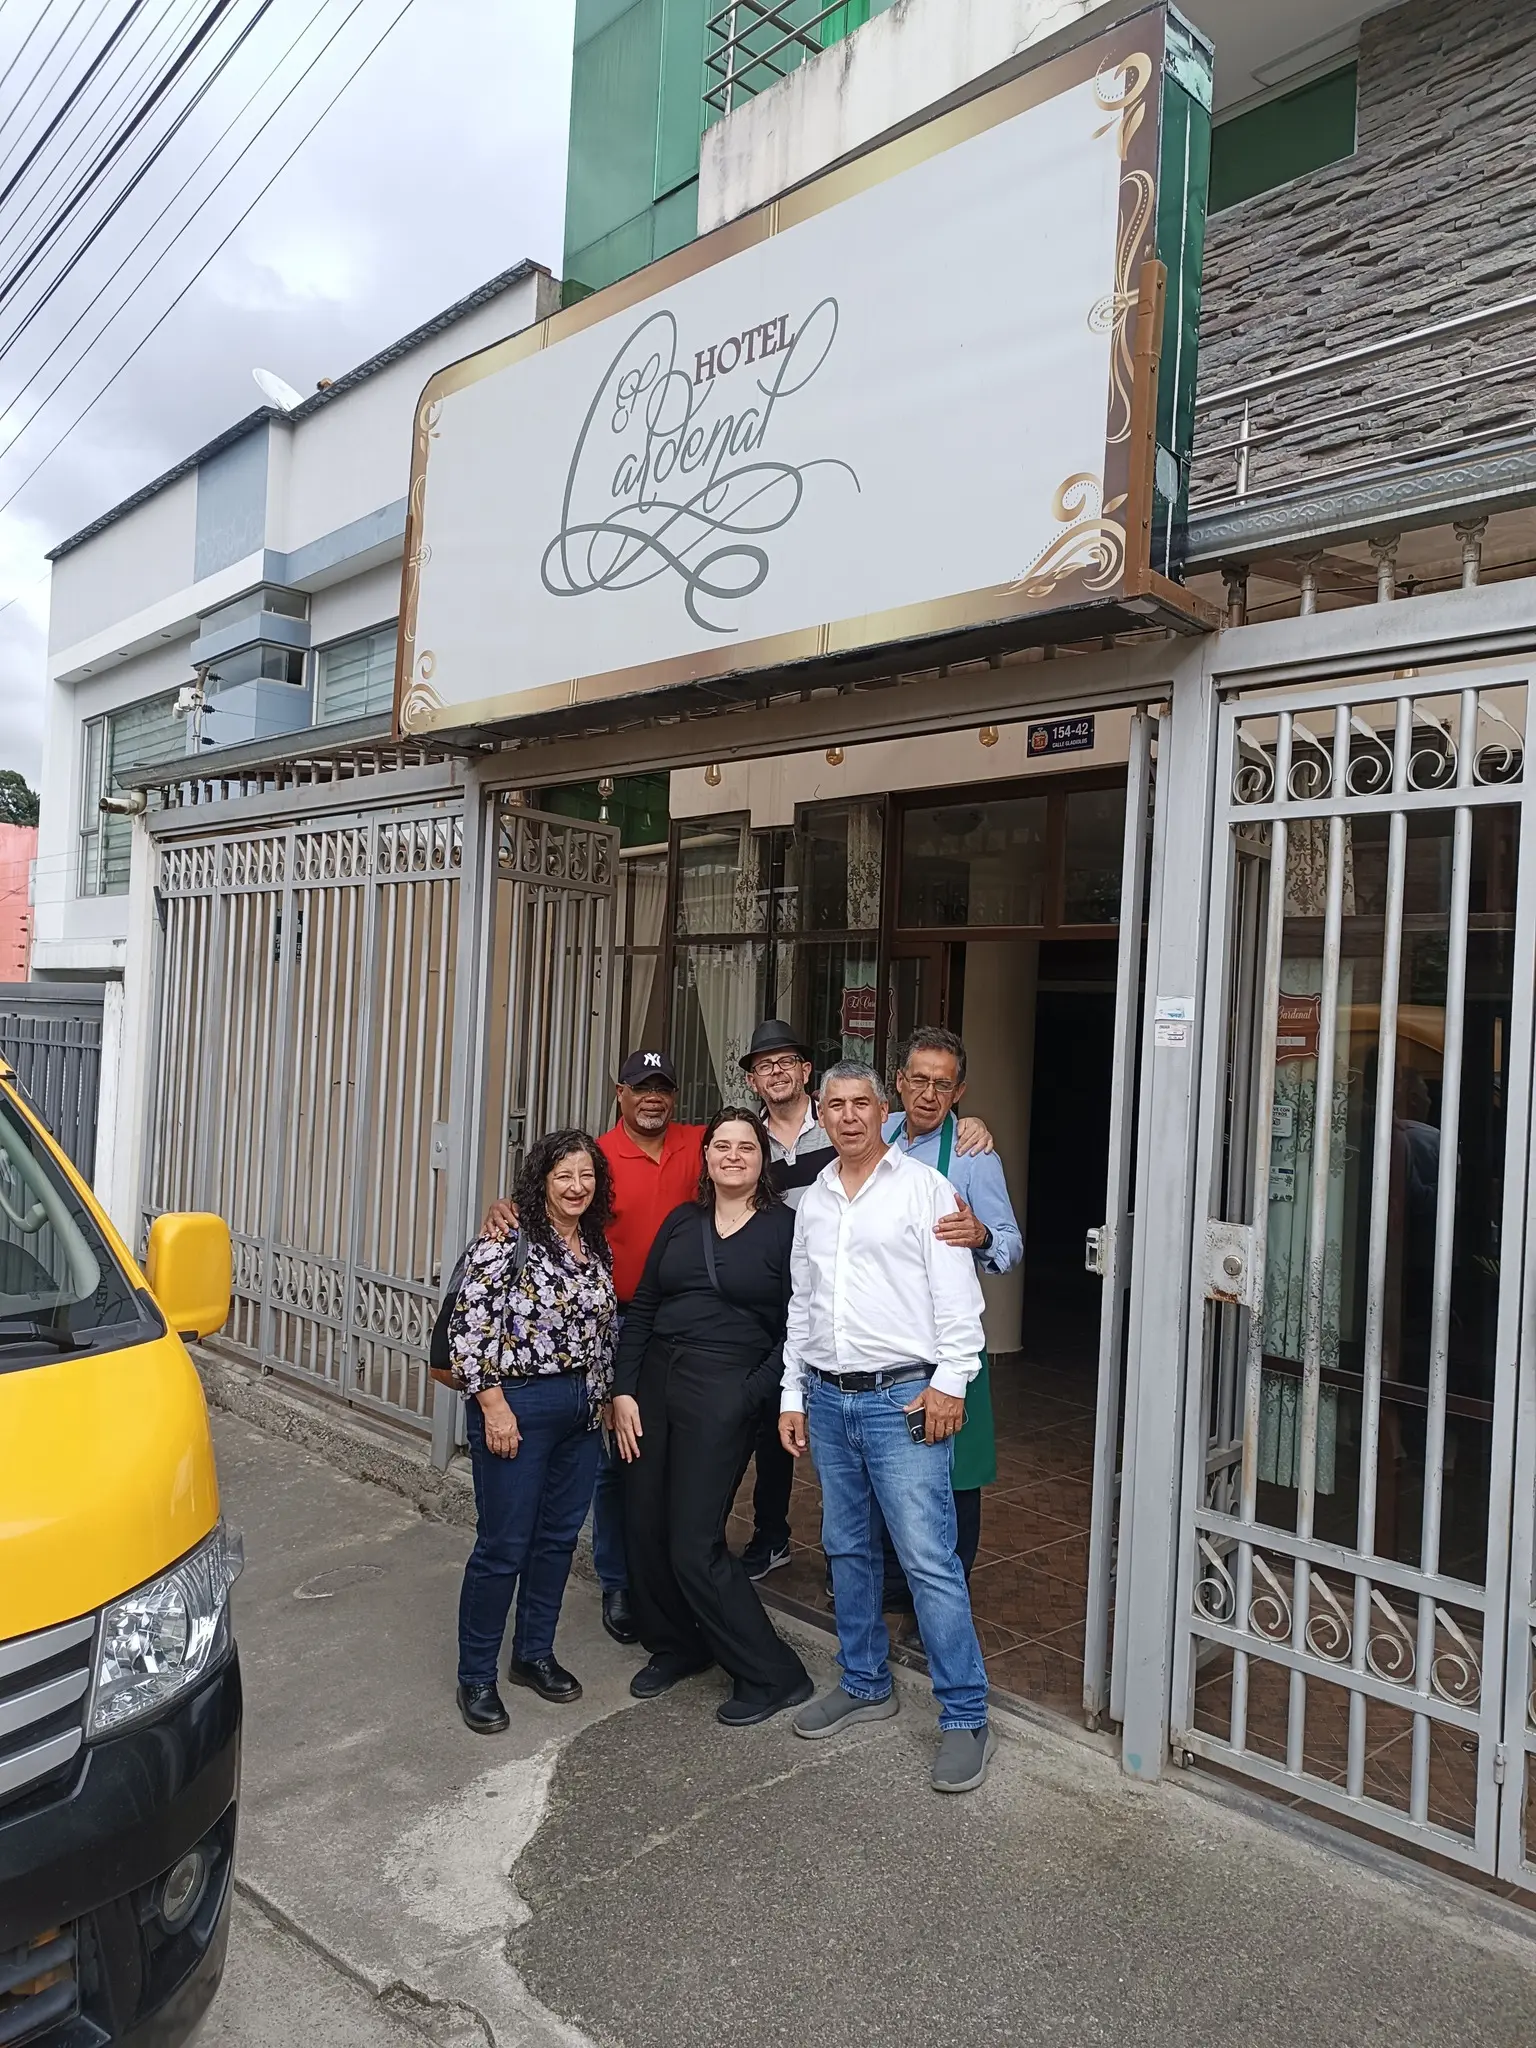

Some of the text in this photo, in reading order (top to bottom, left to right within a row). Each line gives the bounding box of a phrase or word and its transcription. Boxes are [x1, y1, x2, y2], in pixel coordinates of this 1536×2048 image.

[692, 313, 797, 387] HOTEL
[1052, 722, 1089, 739] 154-42
[1052, 741, 1065, 749] CALLE
